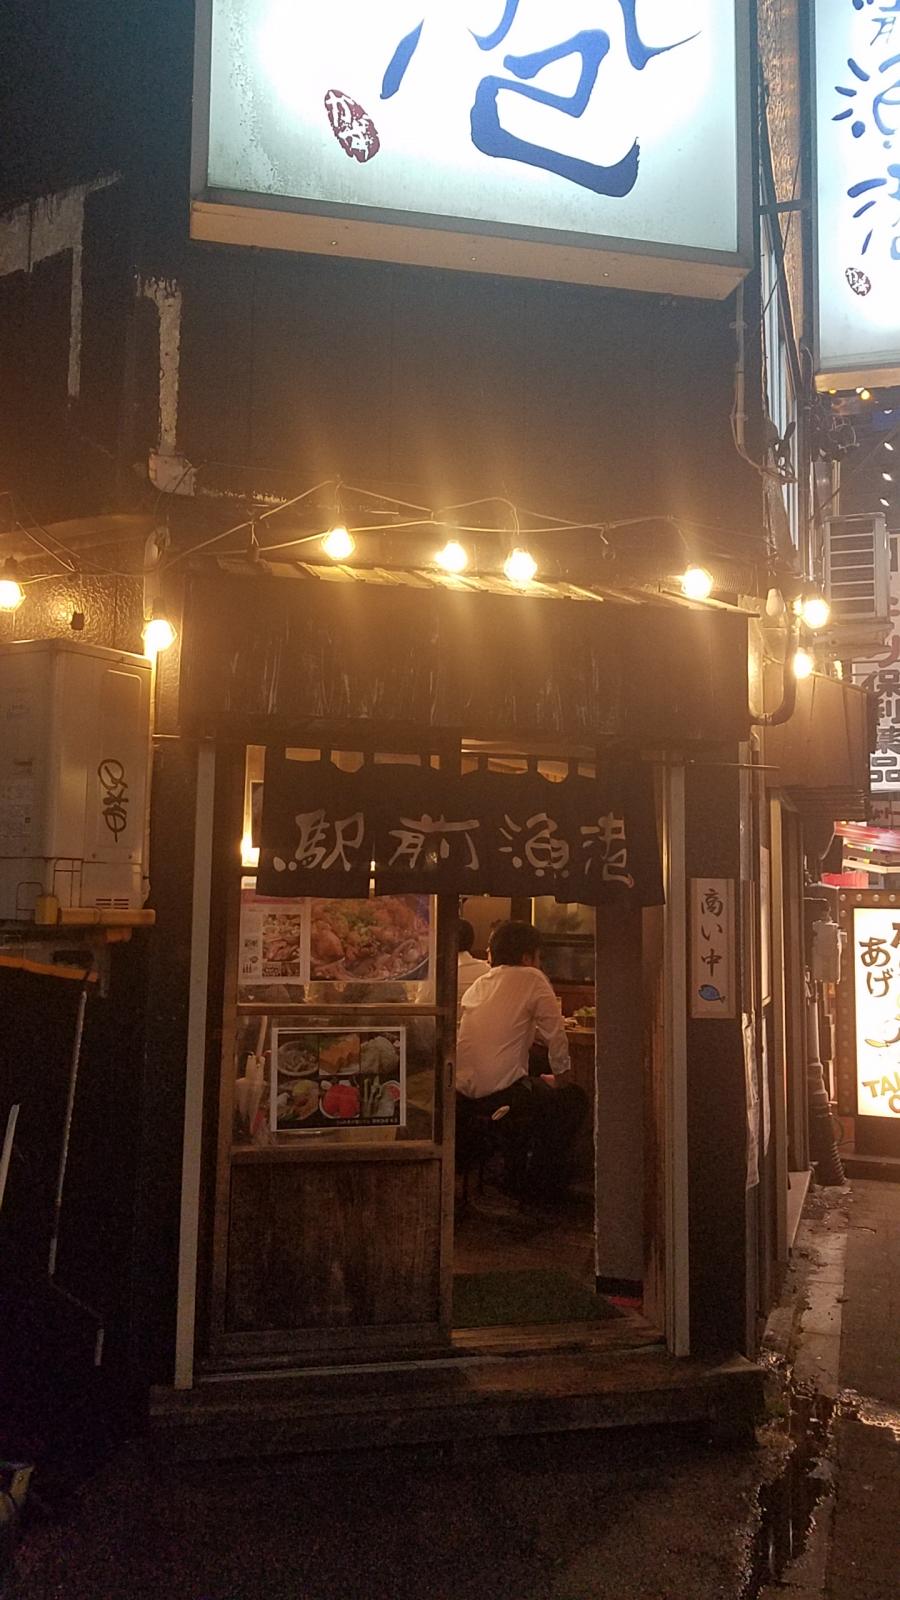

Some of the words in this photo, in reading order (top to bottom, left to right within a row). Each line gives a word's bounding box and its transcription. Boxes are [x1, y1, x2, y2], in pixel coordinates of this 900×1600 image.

[273, 809, 634, 889] 駅前漁港
[701, 888, 723, 977] 商い中
[859, 936, 894, 998] あげ
